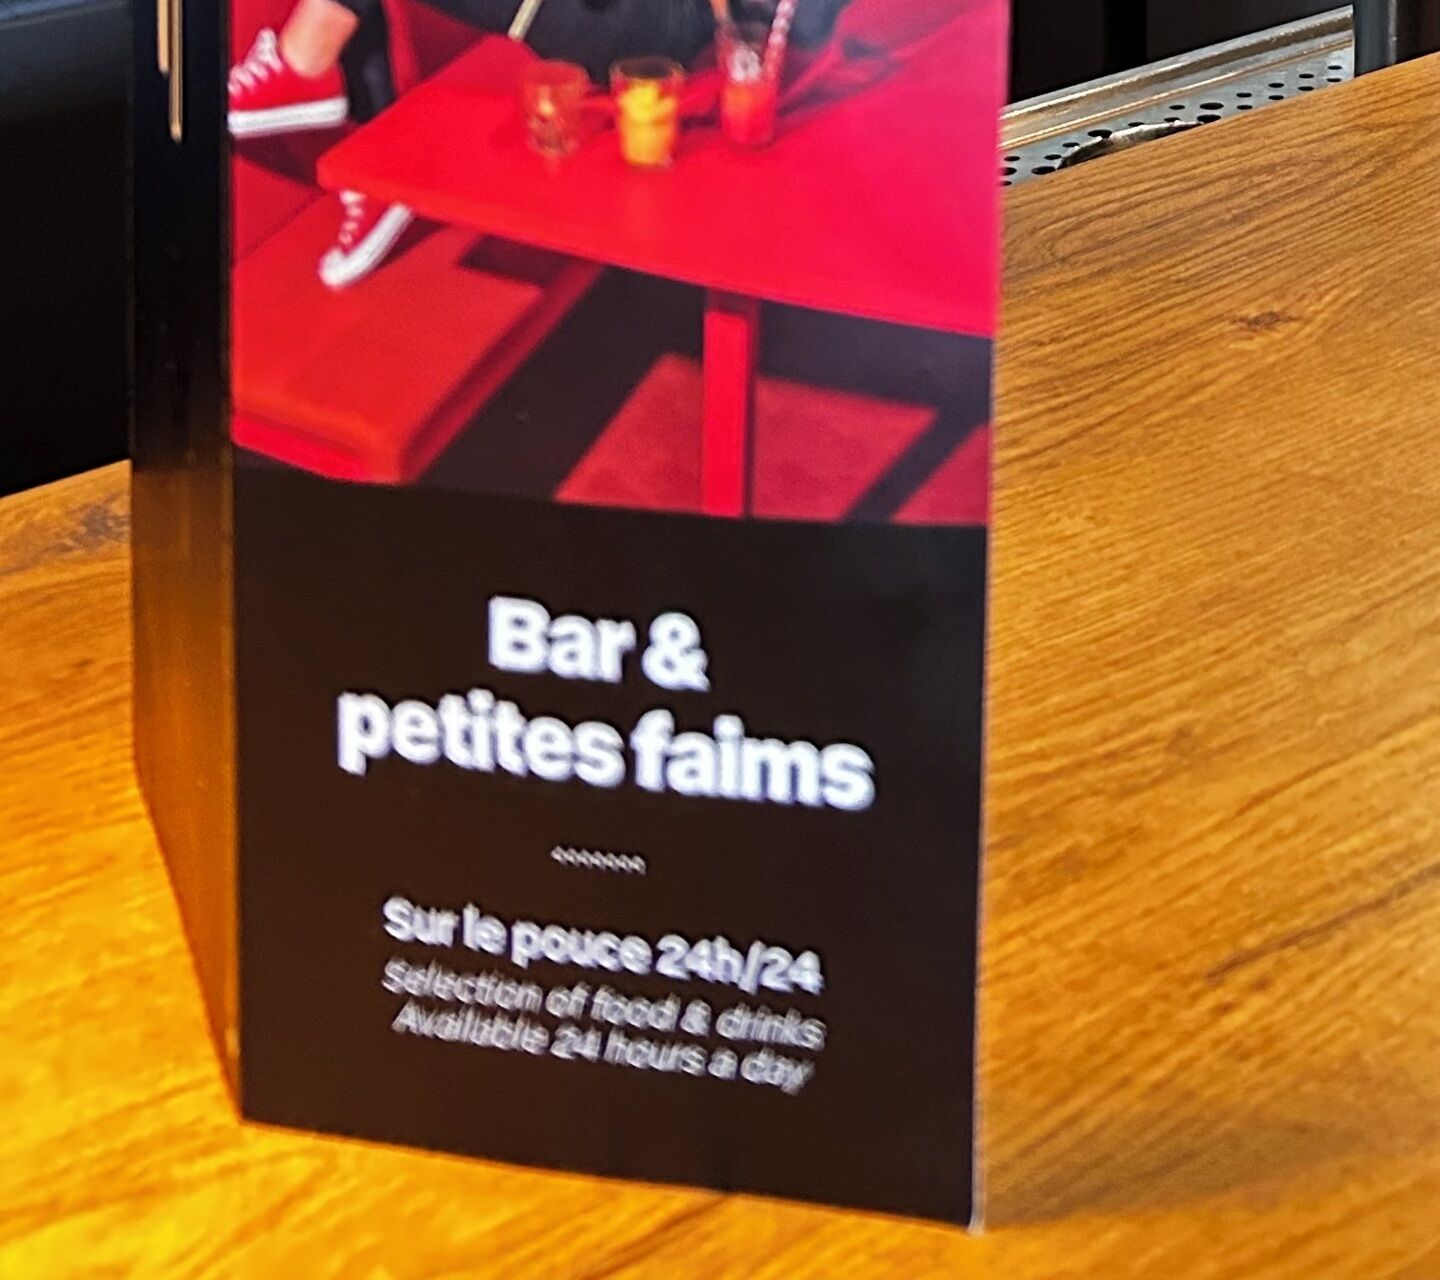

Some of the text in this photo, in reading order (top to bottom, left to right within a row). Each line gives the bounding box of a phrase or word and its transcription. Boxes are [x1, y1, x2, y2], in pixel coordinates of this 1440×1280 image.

[488, 595, 710, 692] Bar &
[337, 688, 876, 812] petites faims
[383, 895, 825, 996] Sur le pouce 24h/24
[381, 957, 827, 1051] Selection of food & drinks
[391, 998, 816, 1096] Available 24 hours a day
